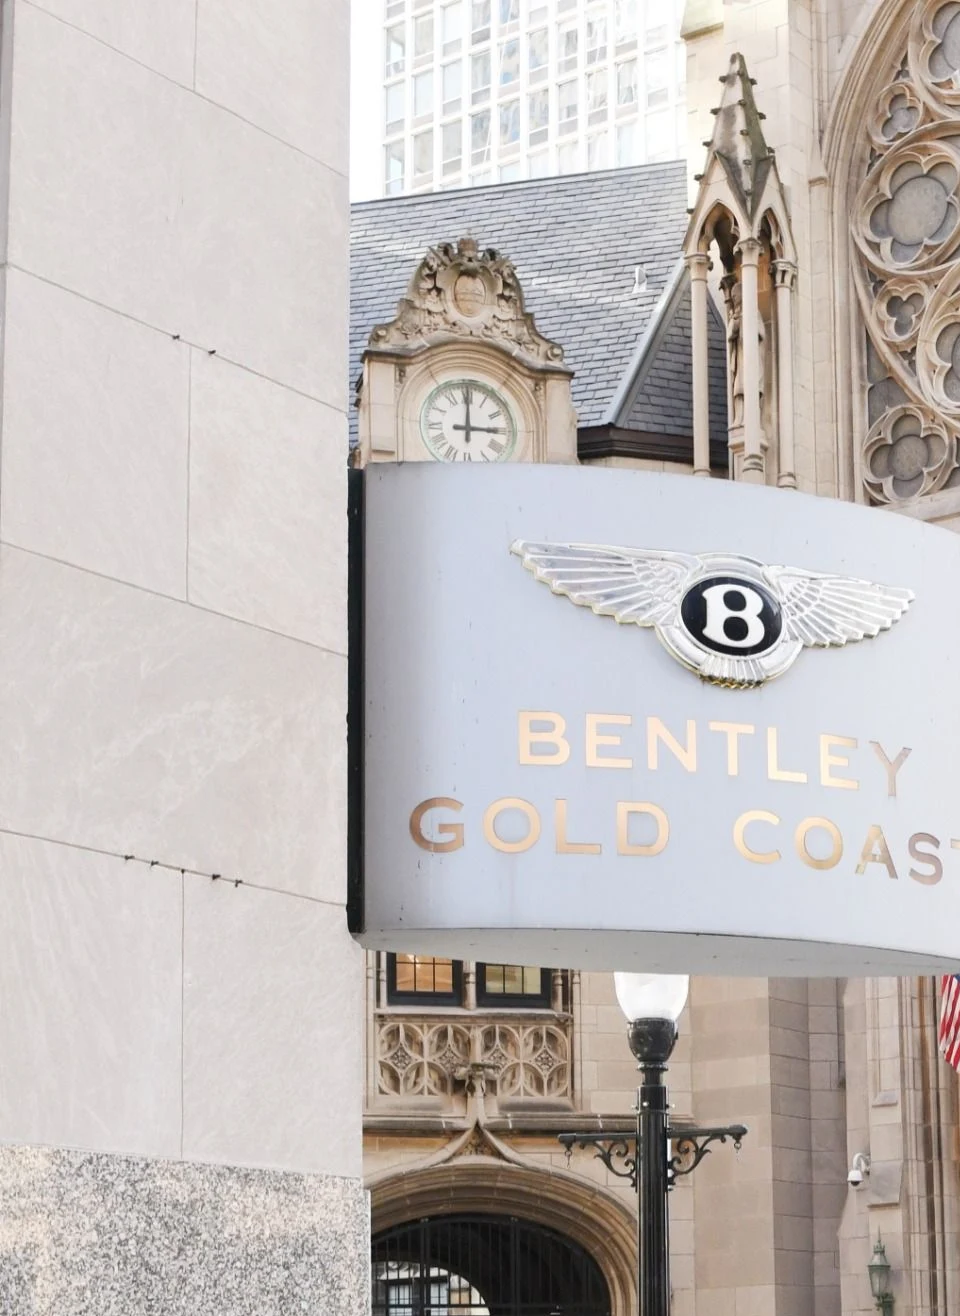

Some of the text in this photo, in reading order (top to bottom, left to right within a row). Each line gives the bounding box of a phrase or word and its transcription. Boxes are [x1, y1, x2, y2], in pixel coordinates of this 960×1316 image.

[701, 584, 766, 650] B
[517, 709, 913, 798] BENTLEY
[408, 796, 671, 857] GOLD
